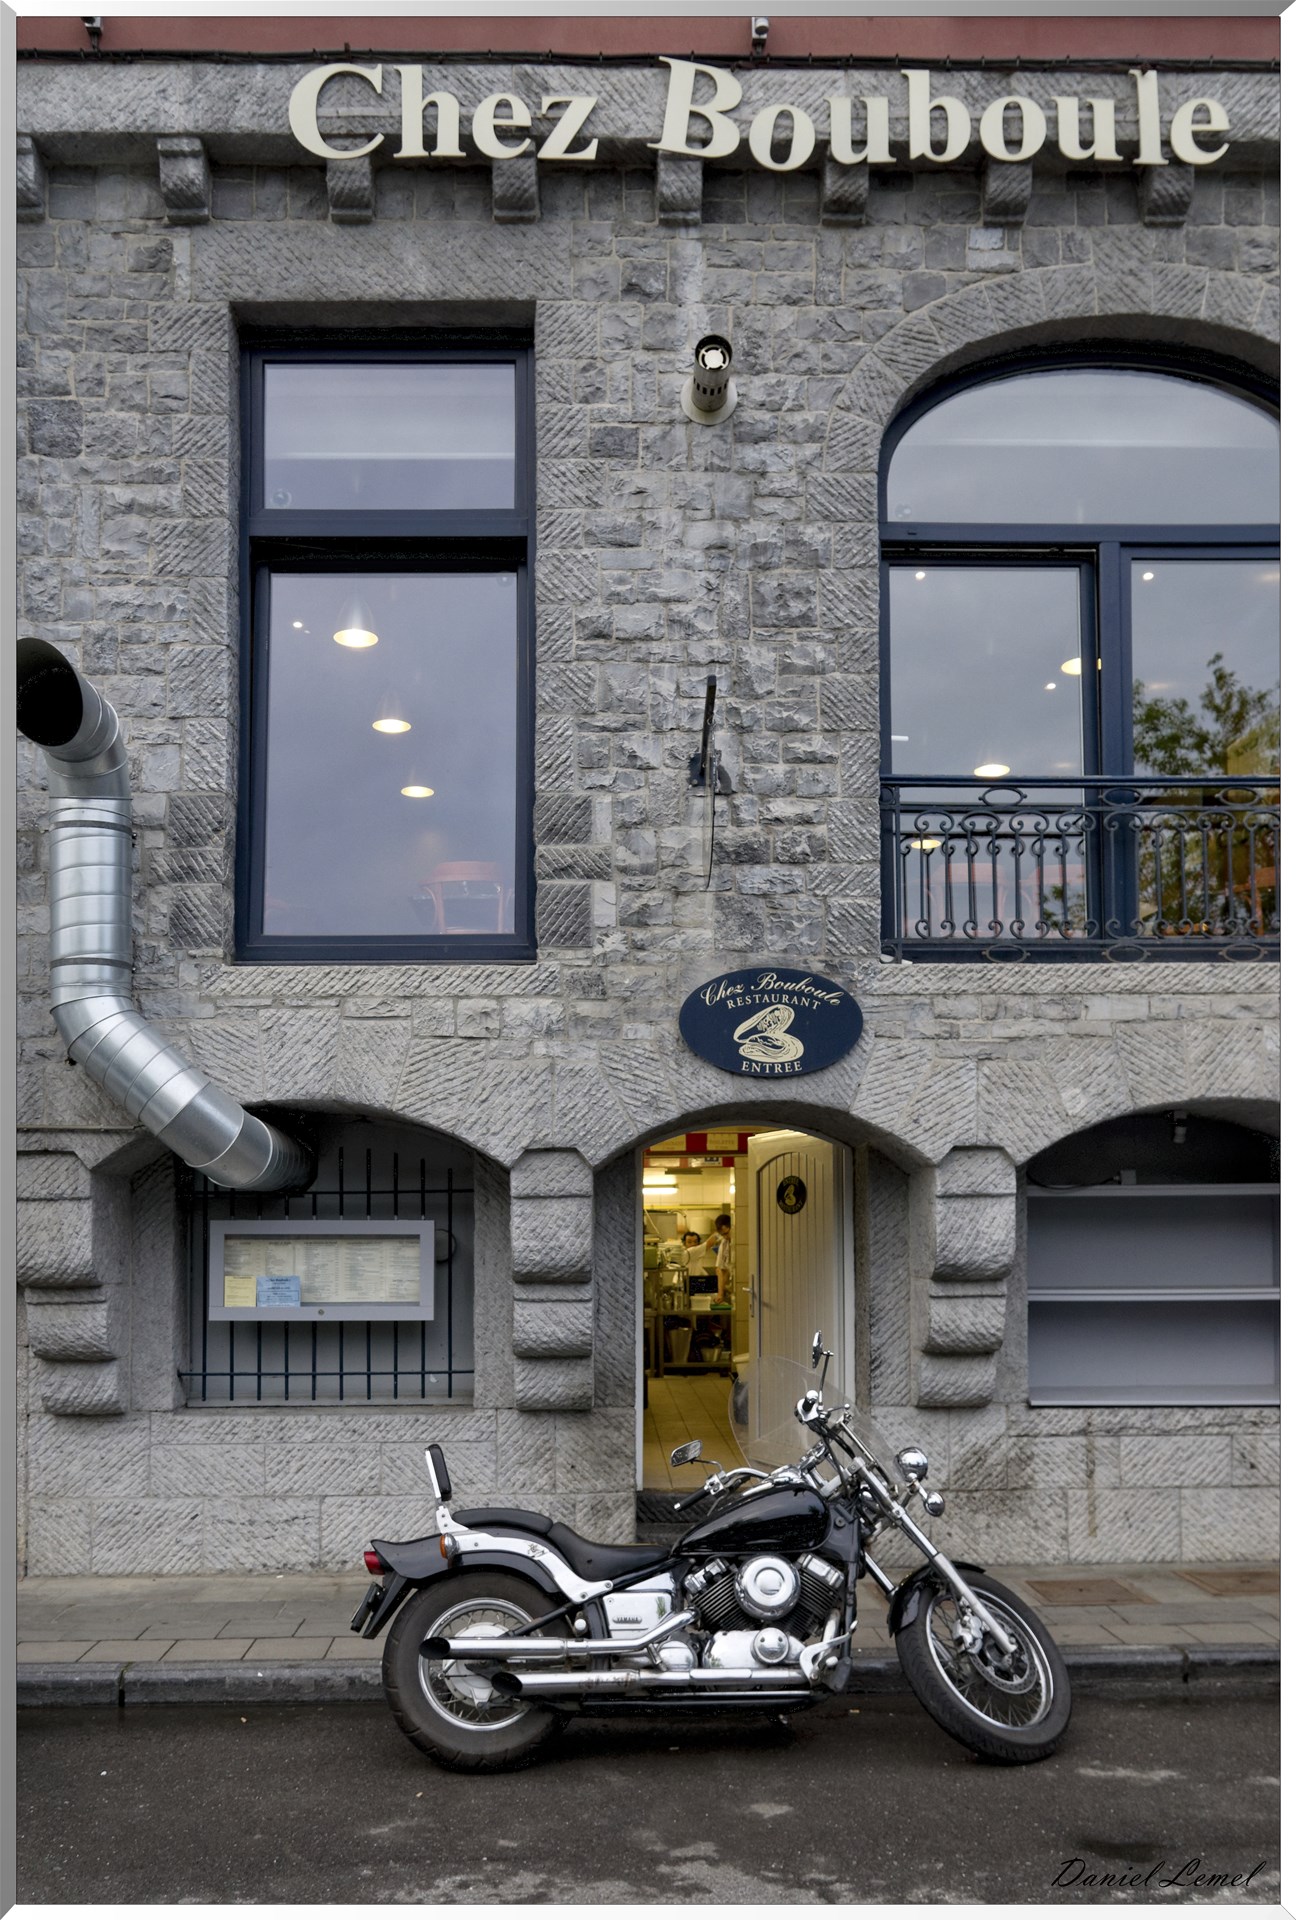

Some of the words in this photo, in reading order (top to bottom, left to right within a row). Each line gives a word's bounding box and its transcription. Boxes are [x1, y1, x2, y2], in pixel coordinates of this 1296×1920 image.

[288, 62, 599, 160] Chez
[646, 56, 1231, 171] Bouboule
[701, 980, 745, 1006] Chez
[751, 972, 845, 1006] Bouboule
[727, 994, 821, 1009] RESTAURANT
[741, 1061, 803, 1073] ENTREE
